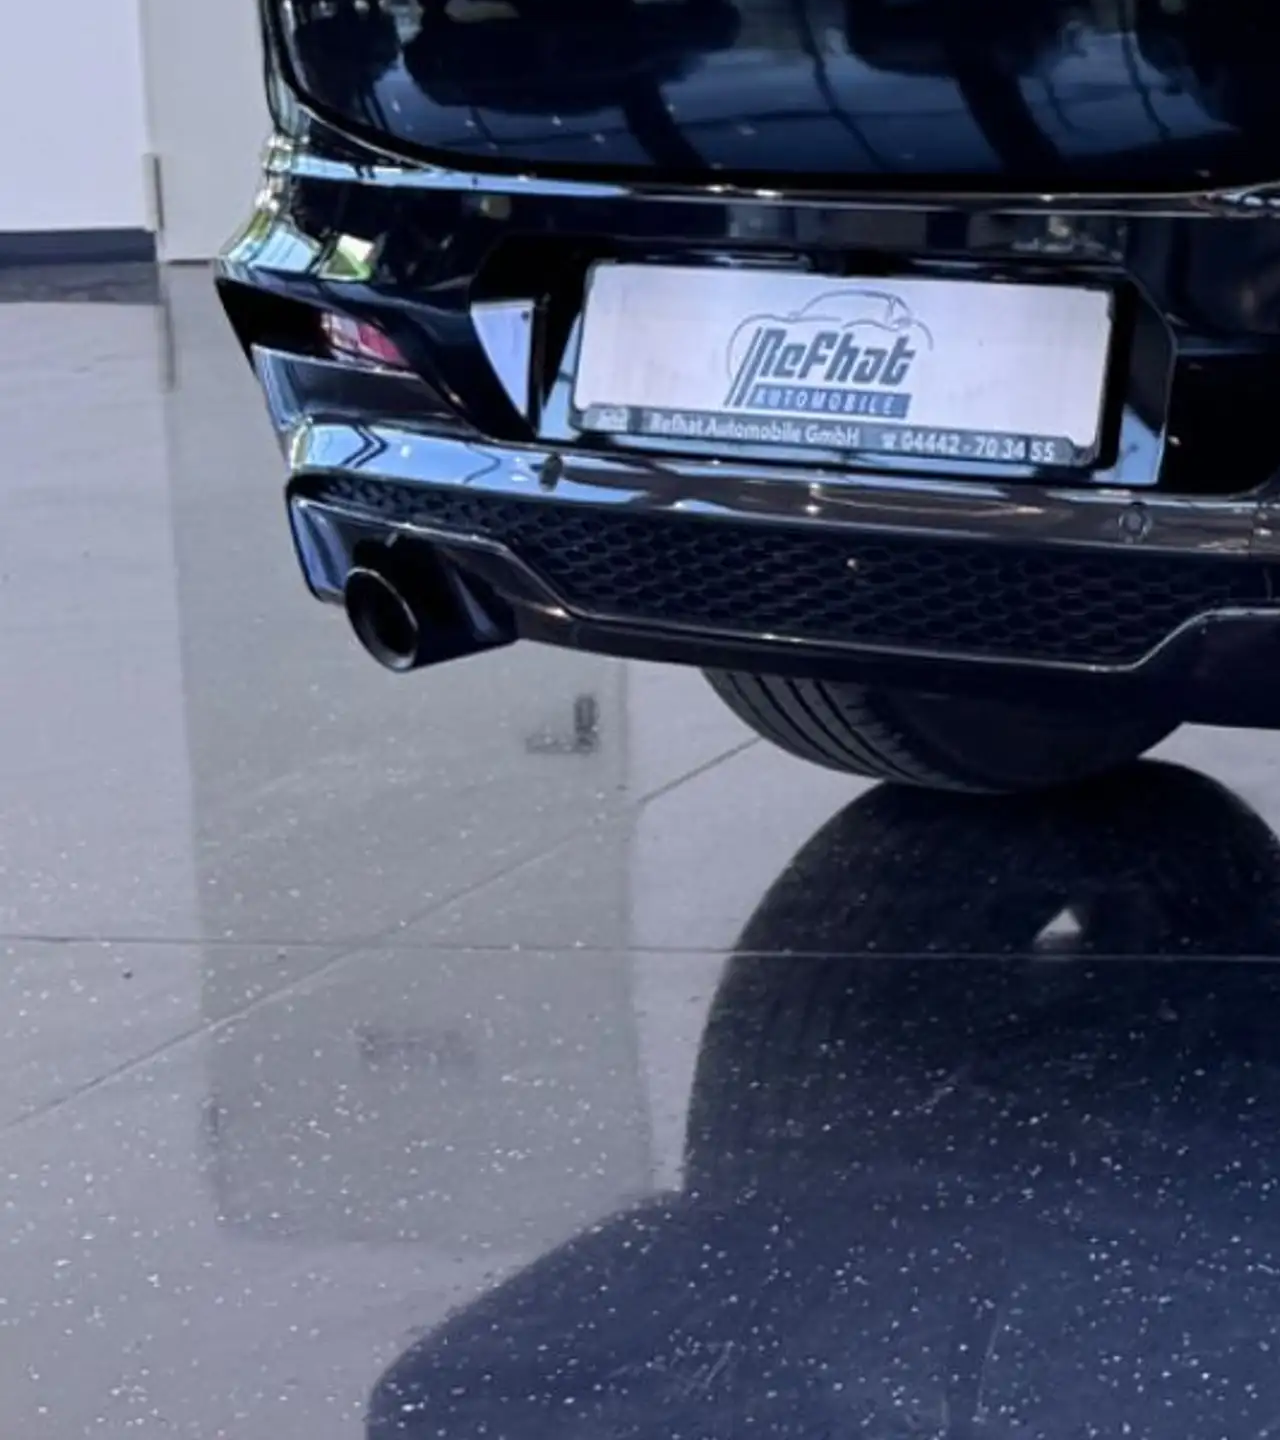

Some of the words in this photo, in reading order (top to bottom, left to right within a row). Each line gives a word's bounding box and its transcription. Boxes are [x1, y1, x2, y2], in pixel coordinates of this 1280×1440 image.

[754, 388, 896, 415] AUTOMOBILE
[704, 417, 801, 444] Automobile
[805, 423, 860, 448] GmbH
[900, 430, 960, 455] 04442
